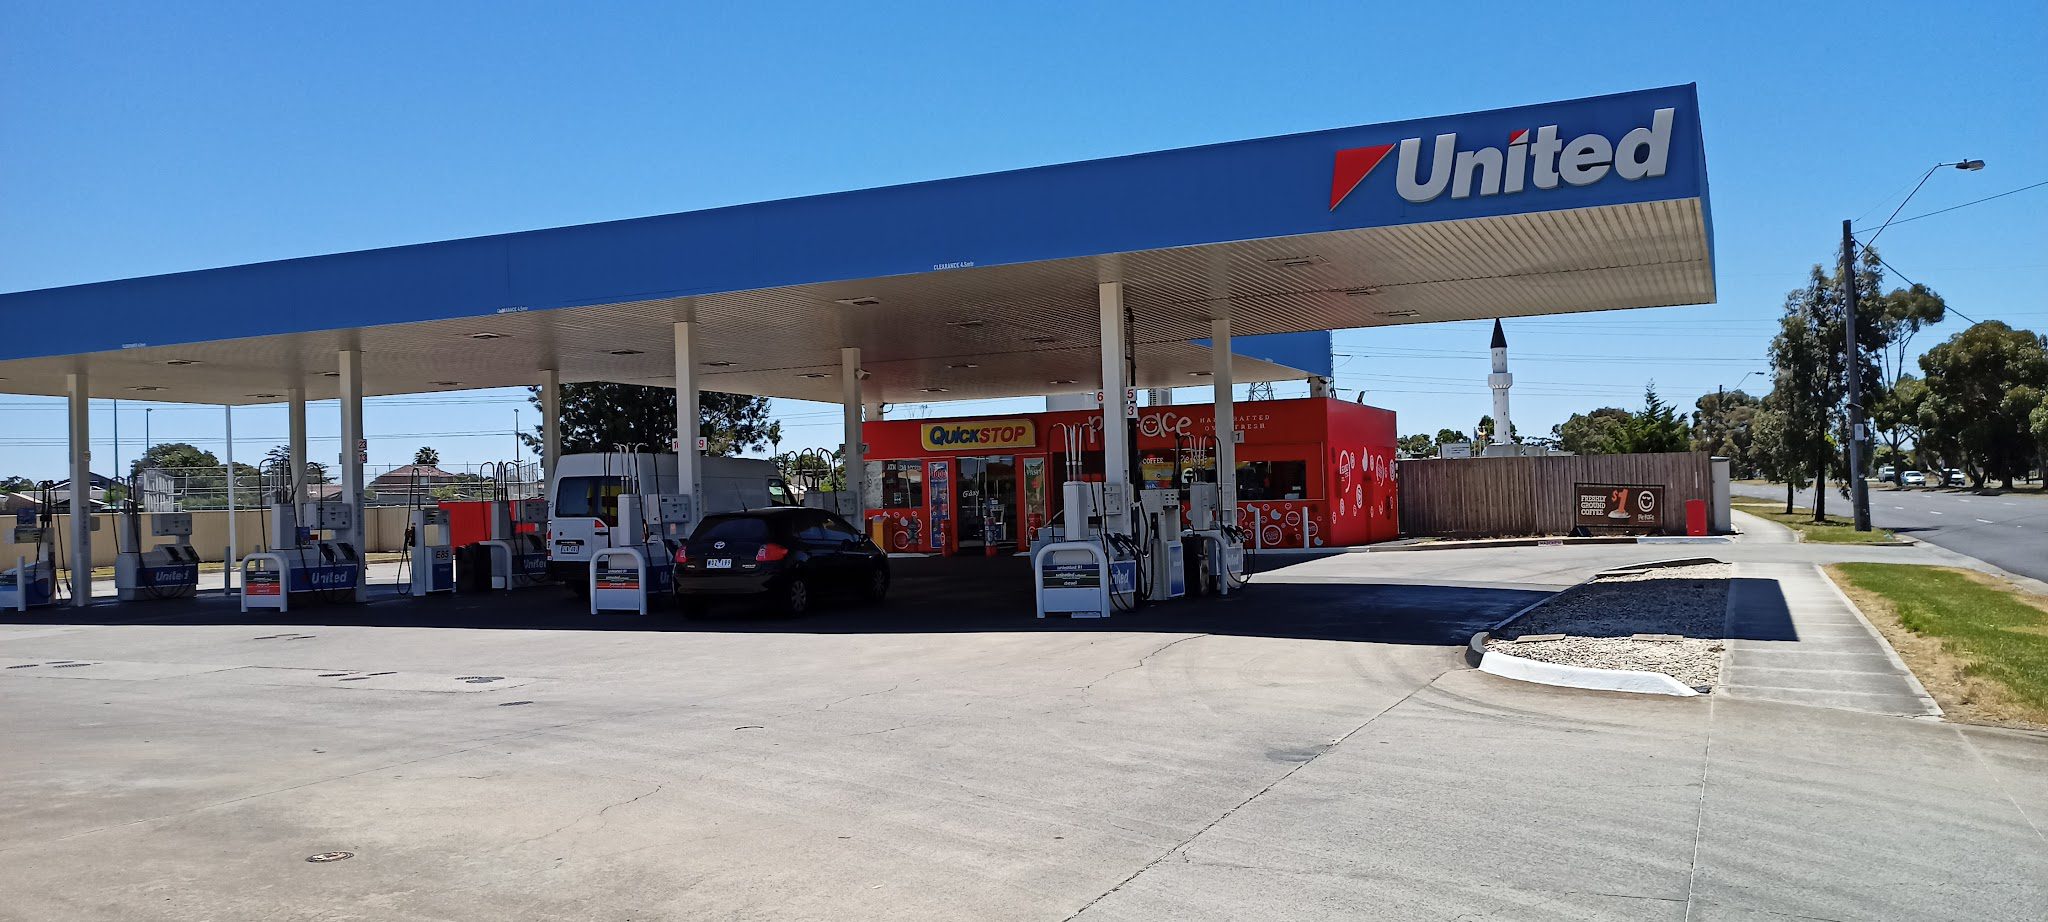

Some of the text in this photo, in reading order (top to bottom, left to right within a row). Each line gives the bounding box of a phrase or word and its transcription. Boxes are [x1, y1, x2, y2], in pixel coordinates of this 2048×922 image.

[1395, 106, 1675, 203] United
[1097, 391, 1104, 401] 6
[1127, 388, 1134, 399] 5
[1127, 406, 1134, 416] 3
[698, 439, 704, 448] 9
[1611, 488, 1629, 513] $1
[311, 571, 348, 584] United
